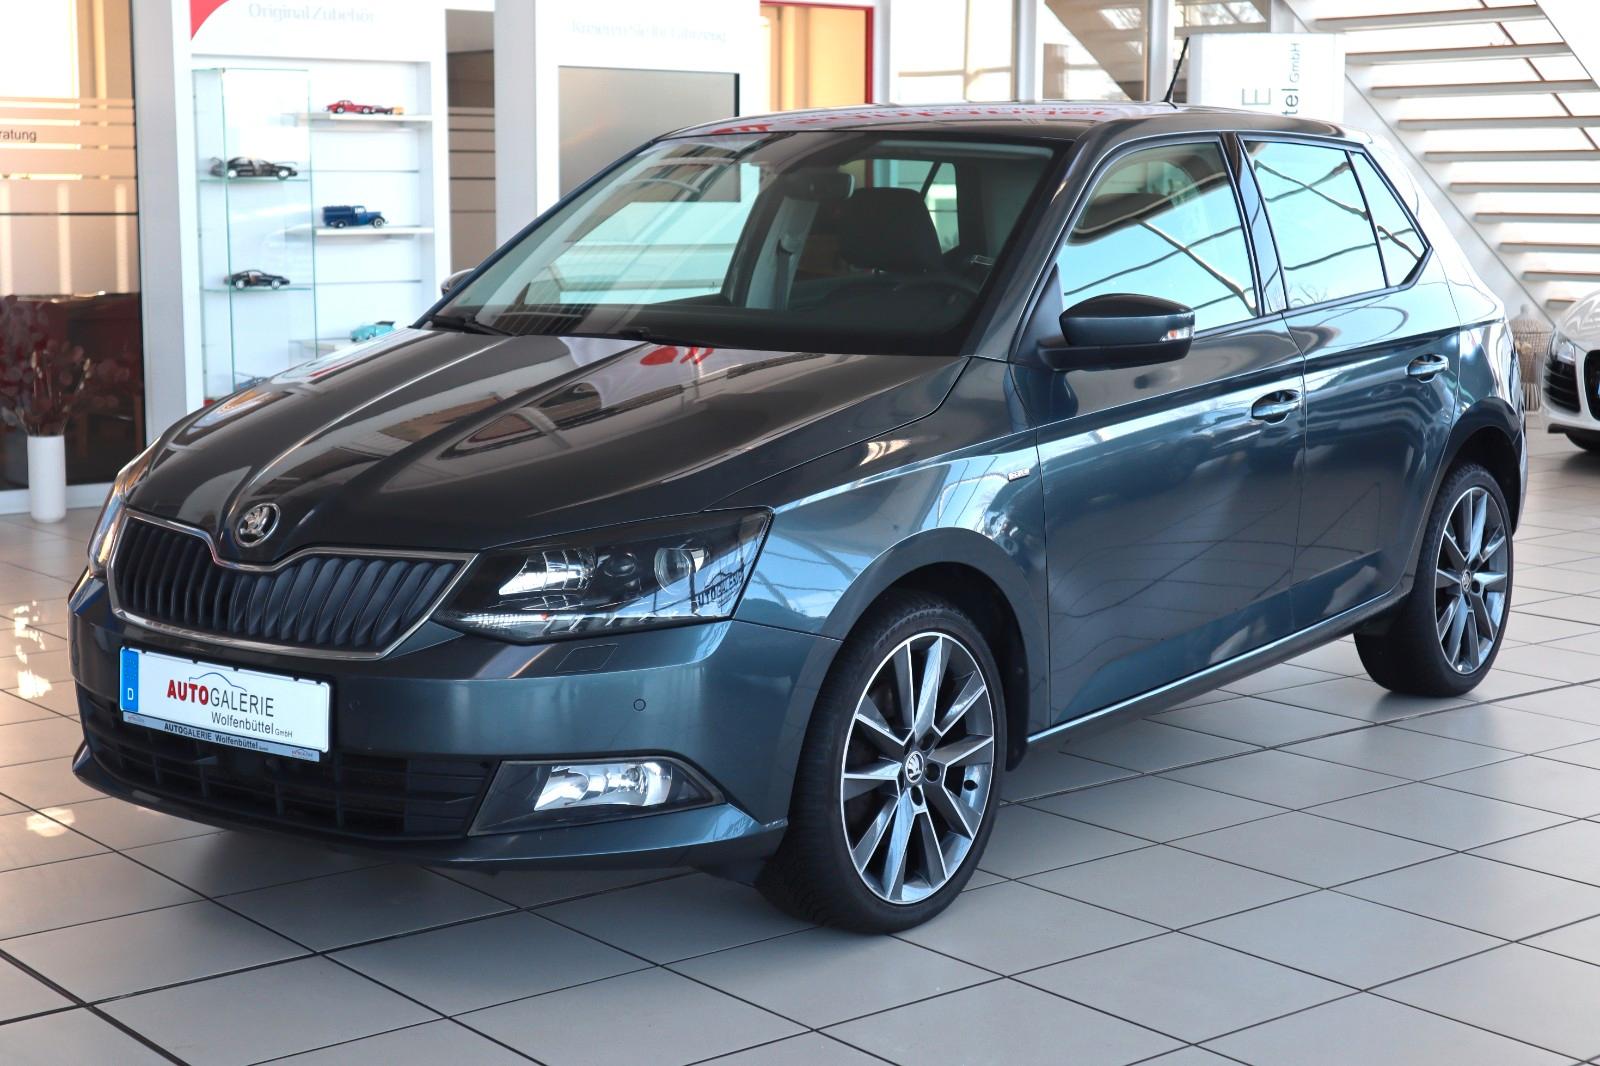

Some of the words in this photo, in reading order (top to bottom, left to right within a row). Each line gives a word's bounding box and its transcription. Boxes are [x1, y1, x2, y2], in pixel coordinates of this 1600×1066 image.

[1289, 42, 1300, 83] GmbH
[1241, 87, 1271, 106] E
[127, 687, 134, 701] D
[167, 679, 274, 717] AUTOGALERIE
[164, 722, 212, 740] AUTOGALERIE
[215, 732, 258, 749] Wolfenbüttel
[211, 711, 274, 735] Wolfenbüttel
[275, 728, 293, 738] GmbH
